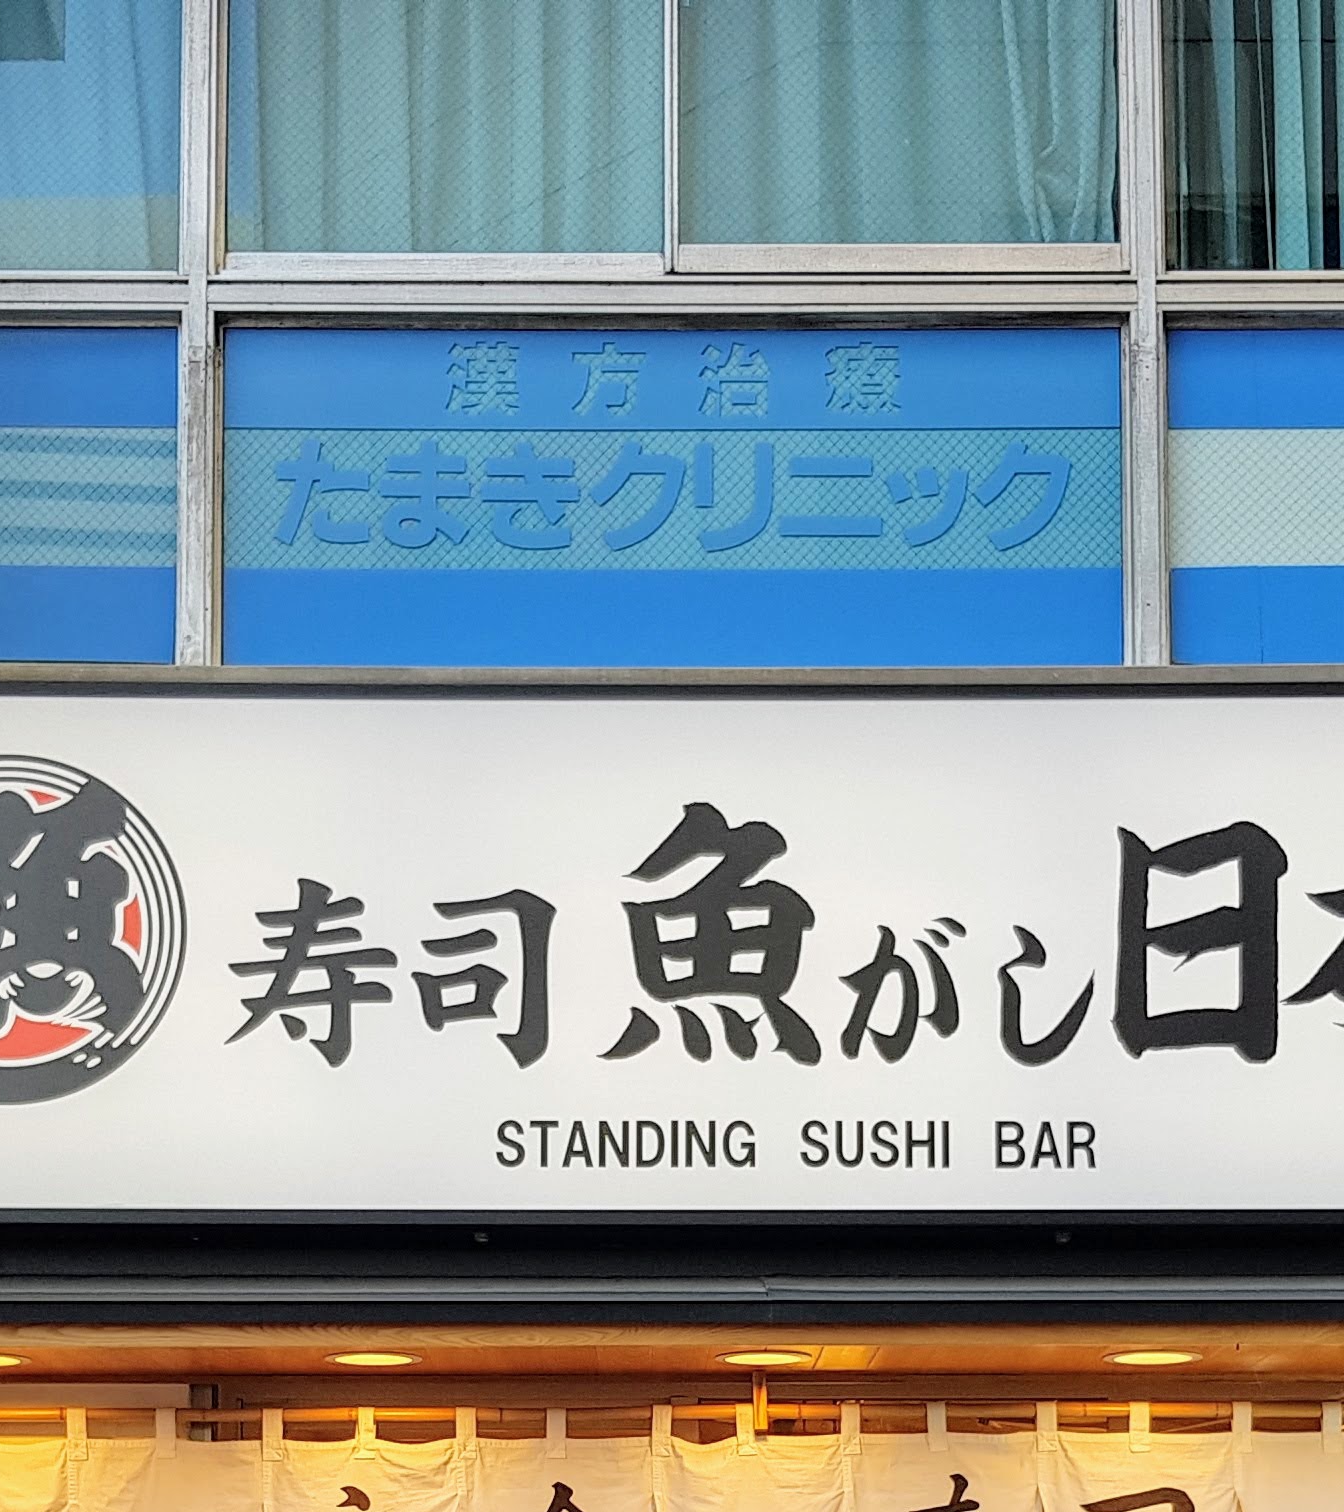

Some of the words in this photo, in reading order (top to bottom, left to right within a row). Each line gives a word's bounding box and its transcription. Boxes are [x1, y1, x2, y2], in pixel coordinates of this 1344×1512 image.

[445, 341, 902, 416] 漢方治療
[274, 439, 1072, 553] たまきクリニック
[223, 878, 557, 1069] 寿司
[495, 1120, 757, 1169] STANDING
[800, 1119, 952, 1168] SUSHI
[994, 1119, 1098, 1168] BAR
